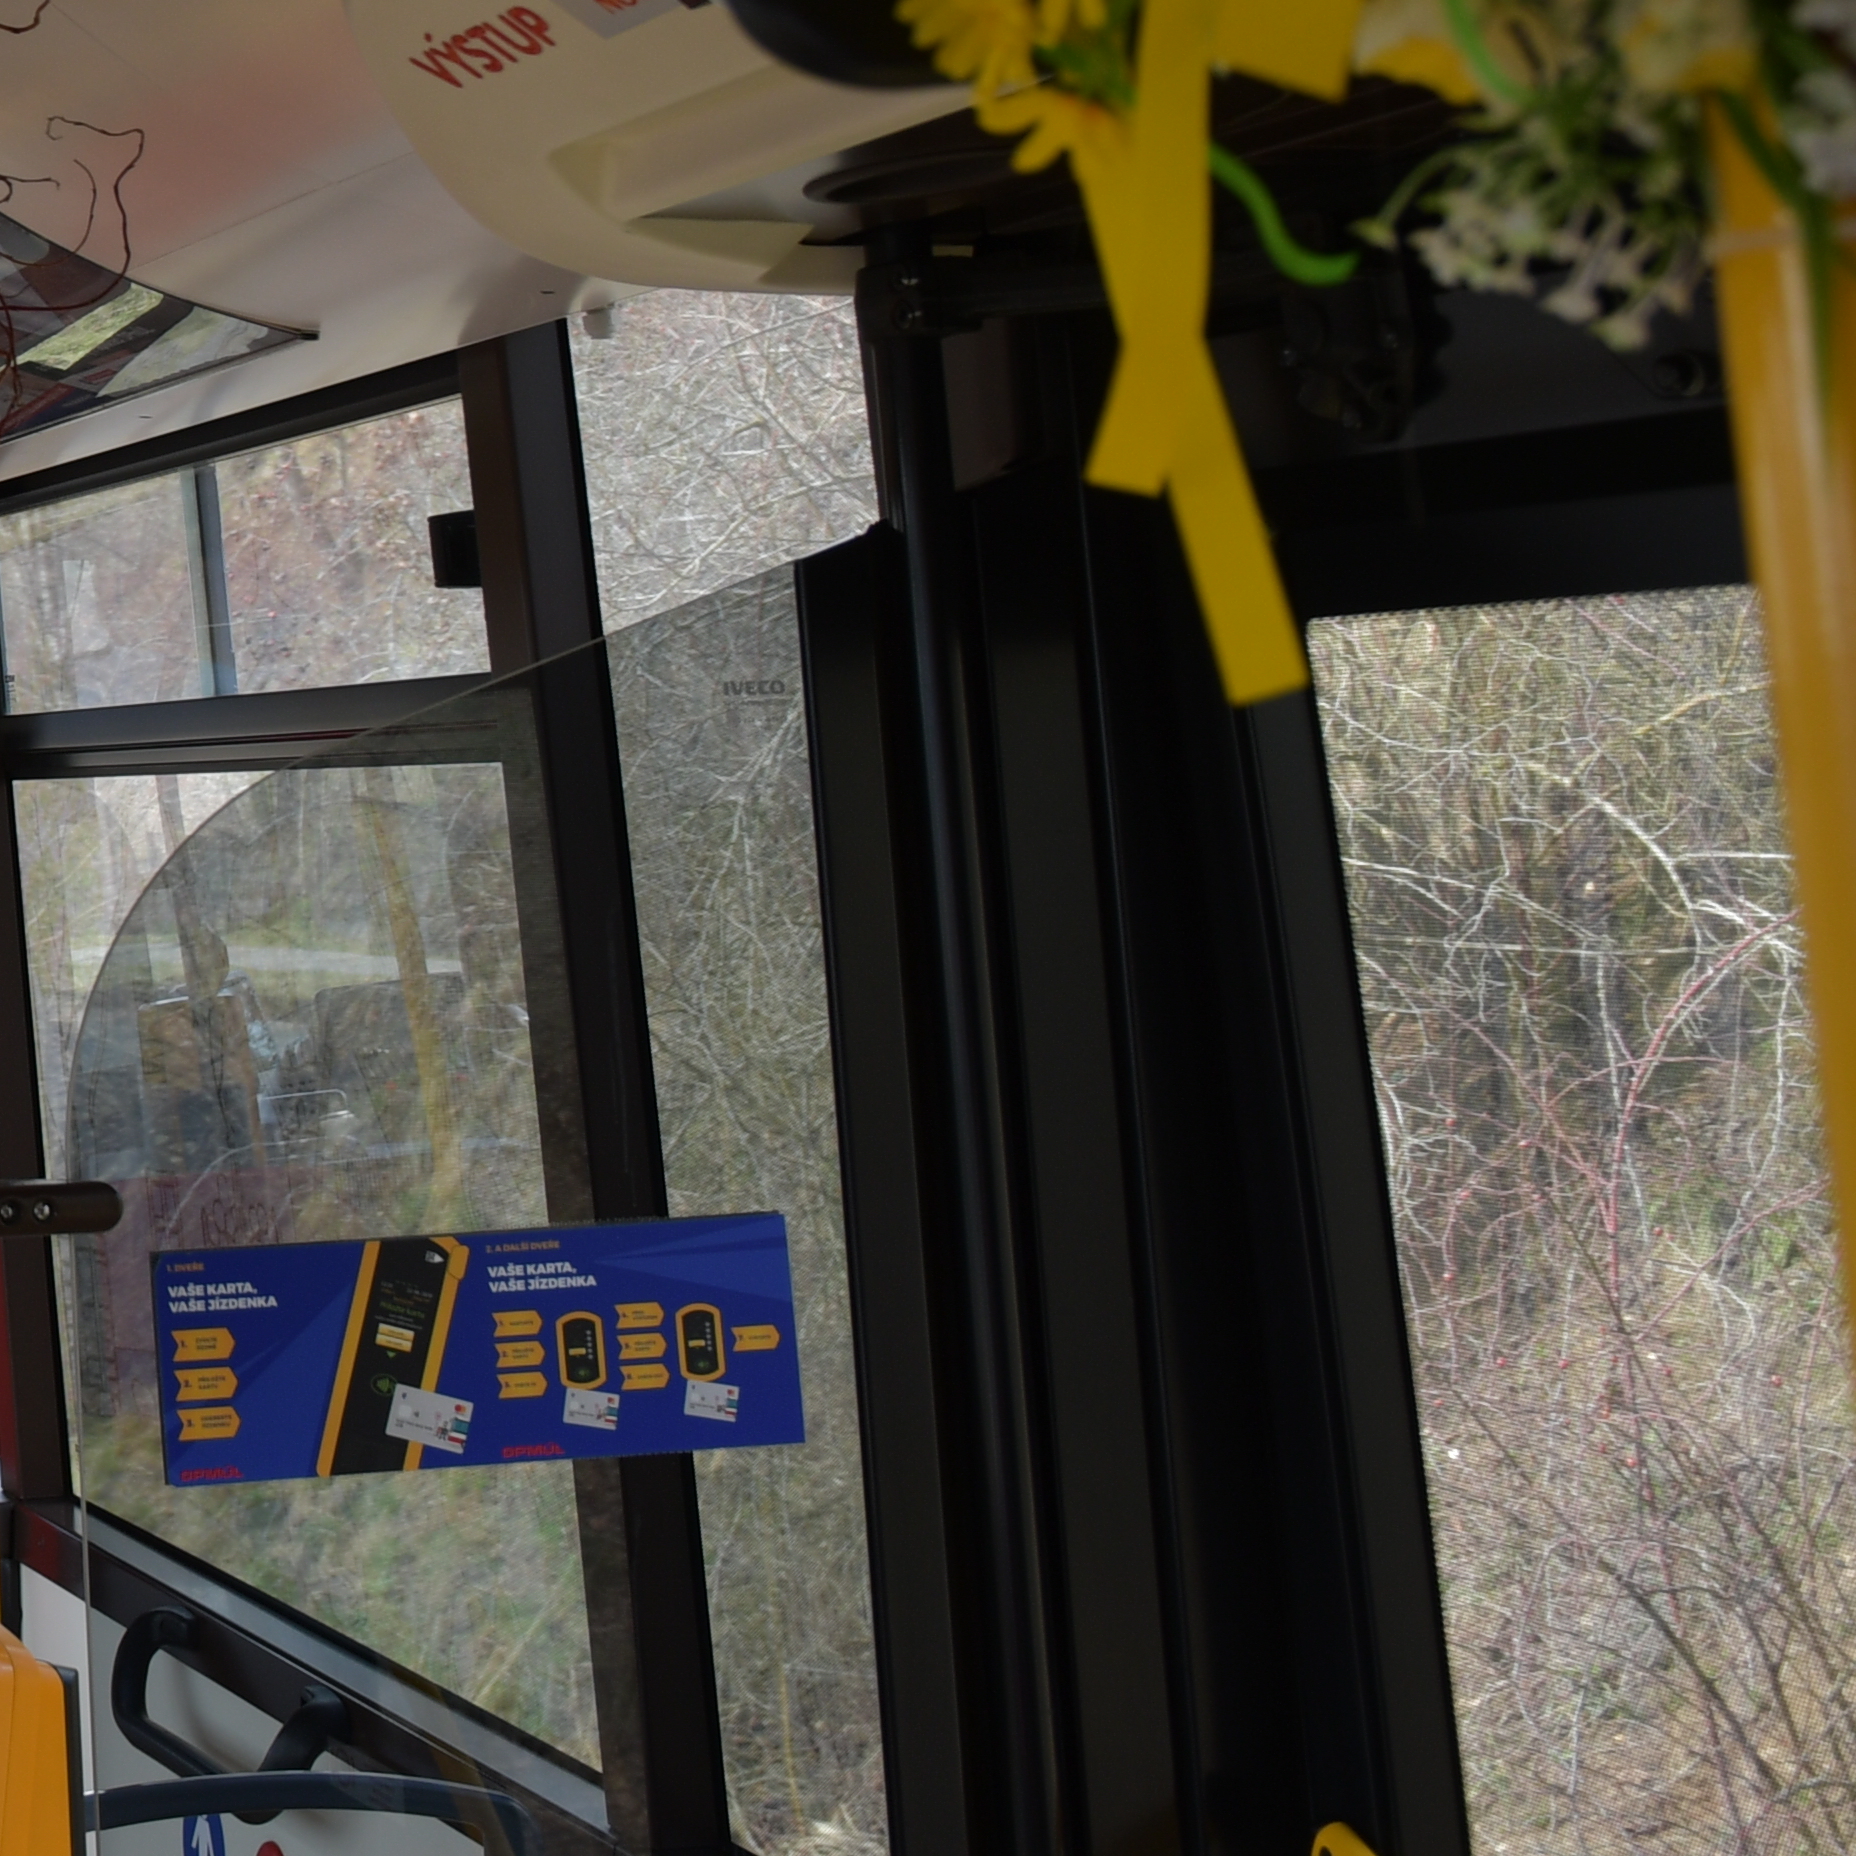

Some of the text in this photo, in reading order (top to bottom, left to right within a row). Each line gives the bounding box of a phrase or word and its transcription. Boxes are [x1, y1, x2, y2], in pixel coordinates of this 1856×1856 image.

[409, 6, 556, 88] VÝSTUP
[723, 680, 786, 696] IVECO
[487, 1261, 577, 1278] VAŠE KARTA,
[168, 1281, 258, 1298] VAŠE KARTA,
[488, 1275, 597, 1293] VAŠE JÍZDENKA
[169, 1295, 278, 1313] VAŠE JÍZDENKA
